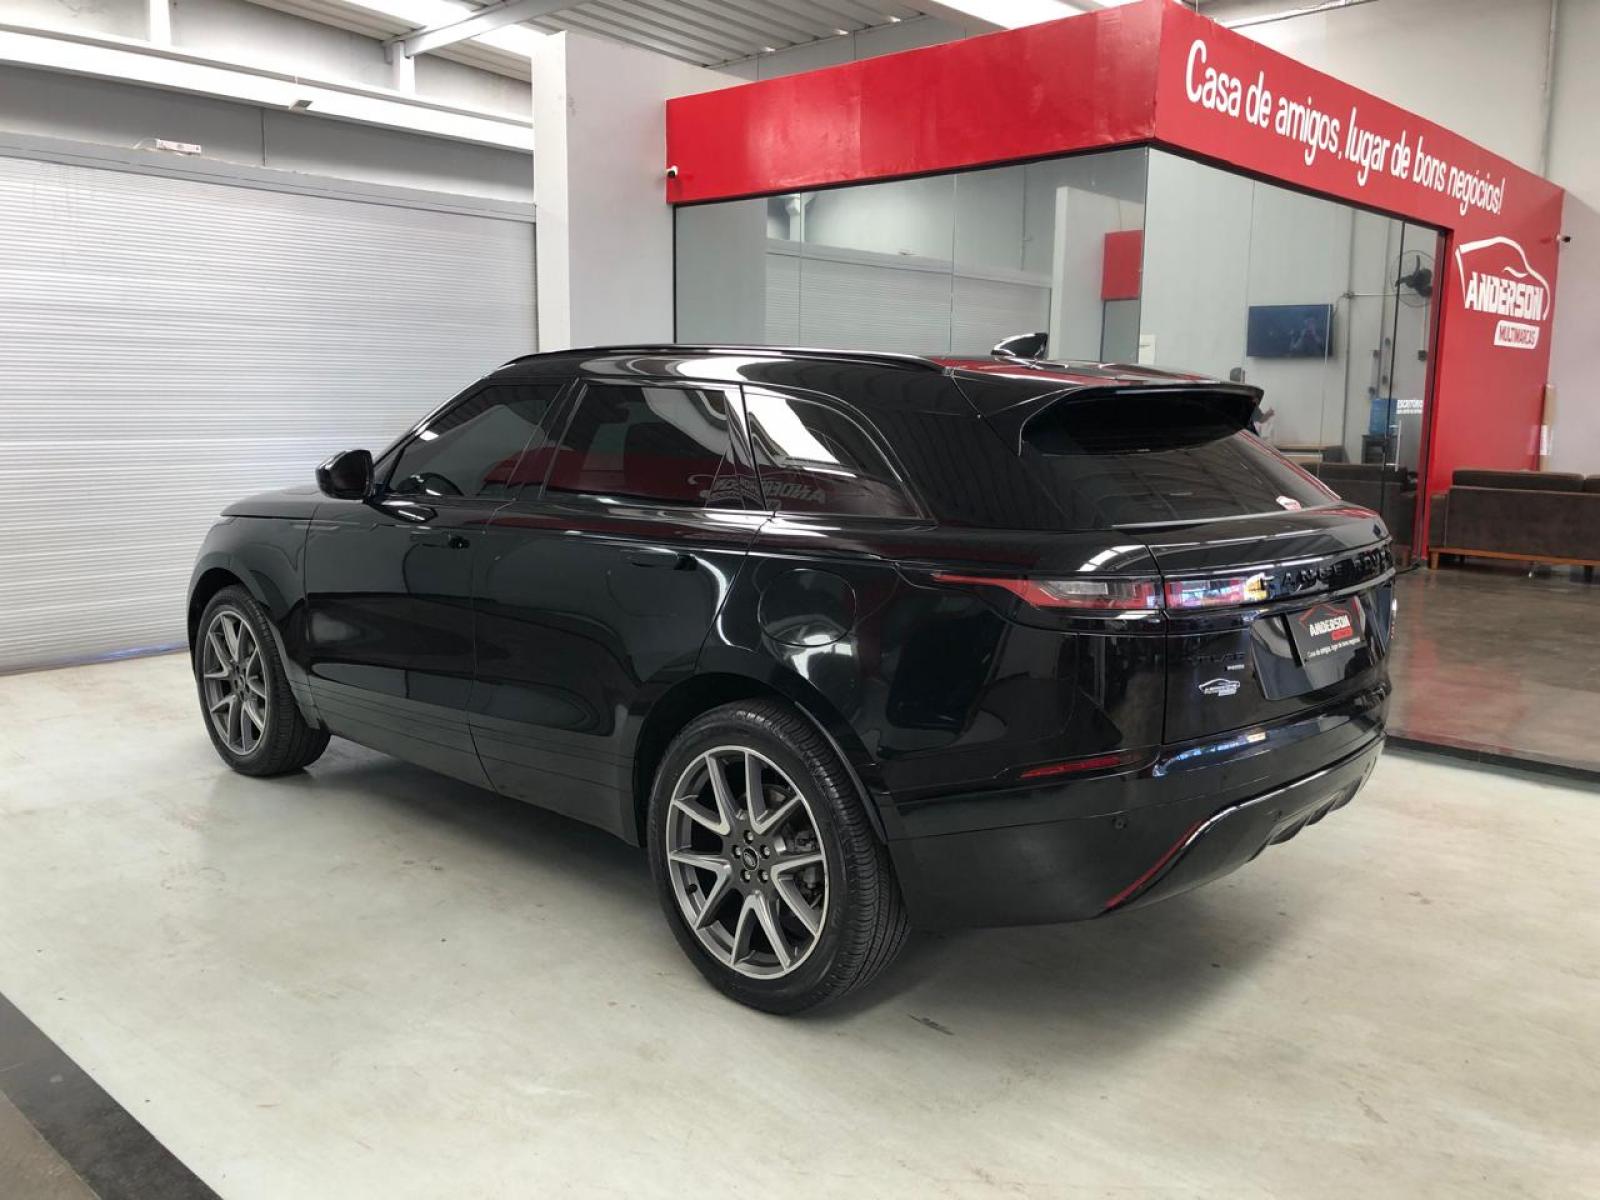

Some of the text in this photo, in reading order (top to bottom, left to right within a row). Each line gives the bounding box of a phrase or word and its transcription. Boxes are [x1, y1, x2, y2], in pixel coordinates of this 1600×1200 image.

[1186, 39, 1242, 118] Casa
[1245, 70, 1272, 129] de
[1275, 95, 1342, 166] amigos,
[1344, 106, 1391, 187] lugar
[1390, 129, 1411, 180] de
[1412, 135, 1447, 192] bons
[1464, 271, 1545, 321] ANDERSON
[1309, 614, 1351, 637] ANDERSON
